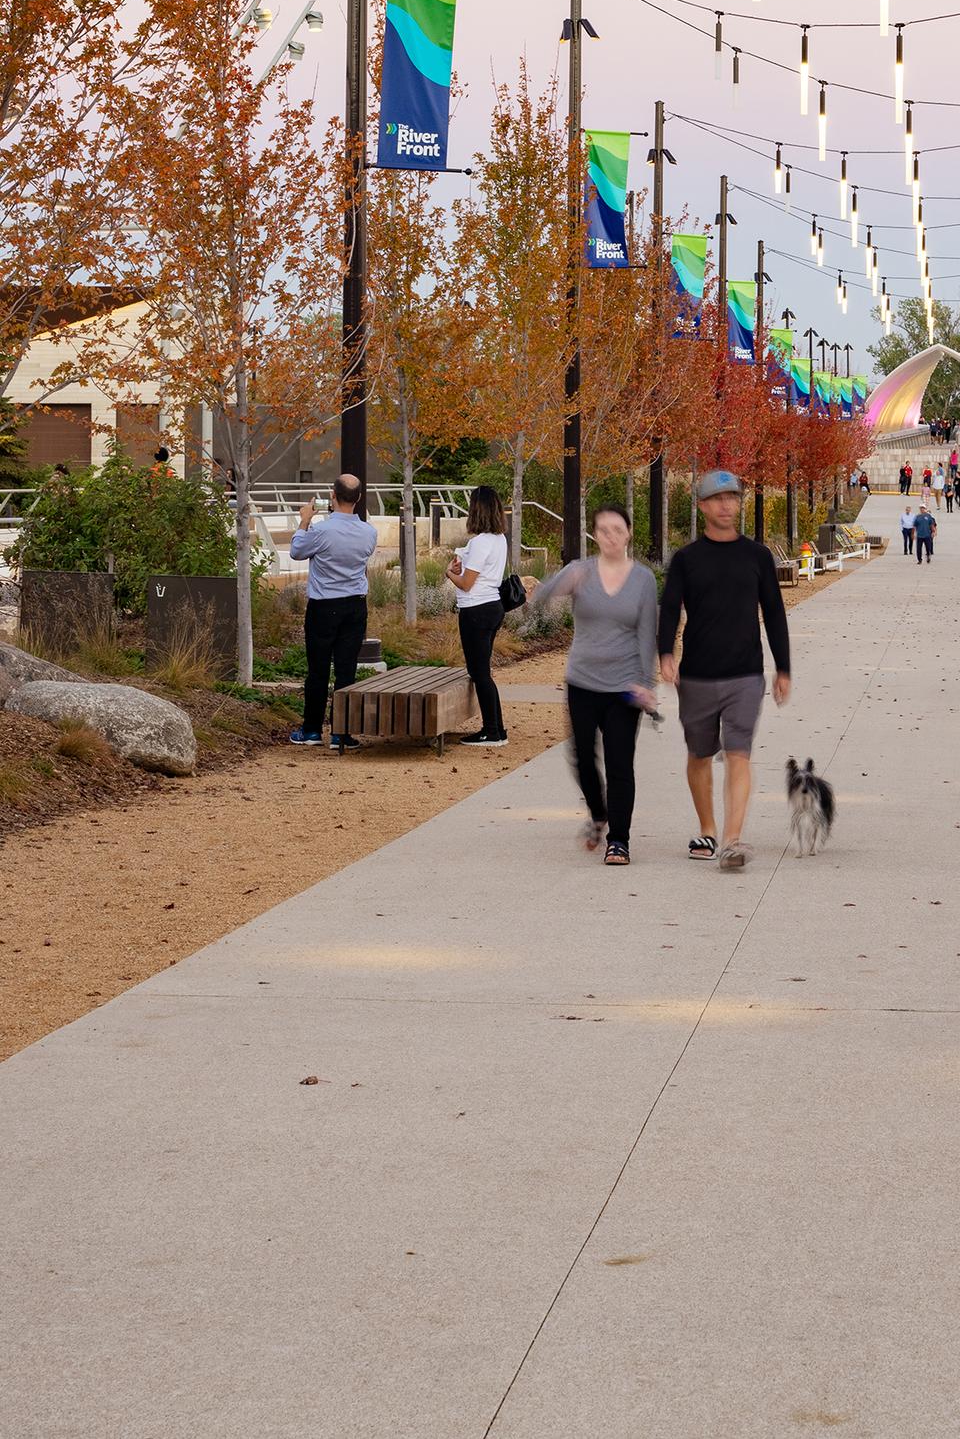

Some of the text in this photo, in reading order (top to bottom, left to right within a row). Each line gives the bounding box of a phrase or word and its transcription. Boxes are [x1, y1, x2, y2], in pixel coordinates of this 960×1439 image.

[398, 128, 439, 144] River
[396, 142, 440, 157] Front
[596, 241, 622, 251] River
[596, 250, 624, 259] Front
